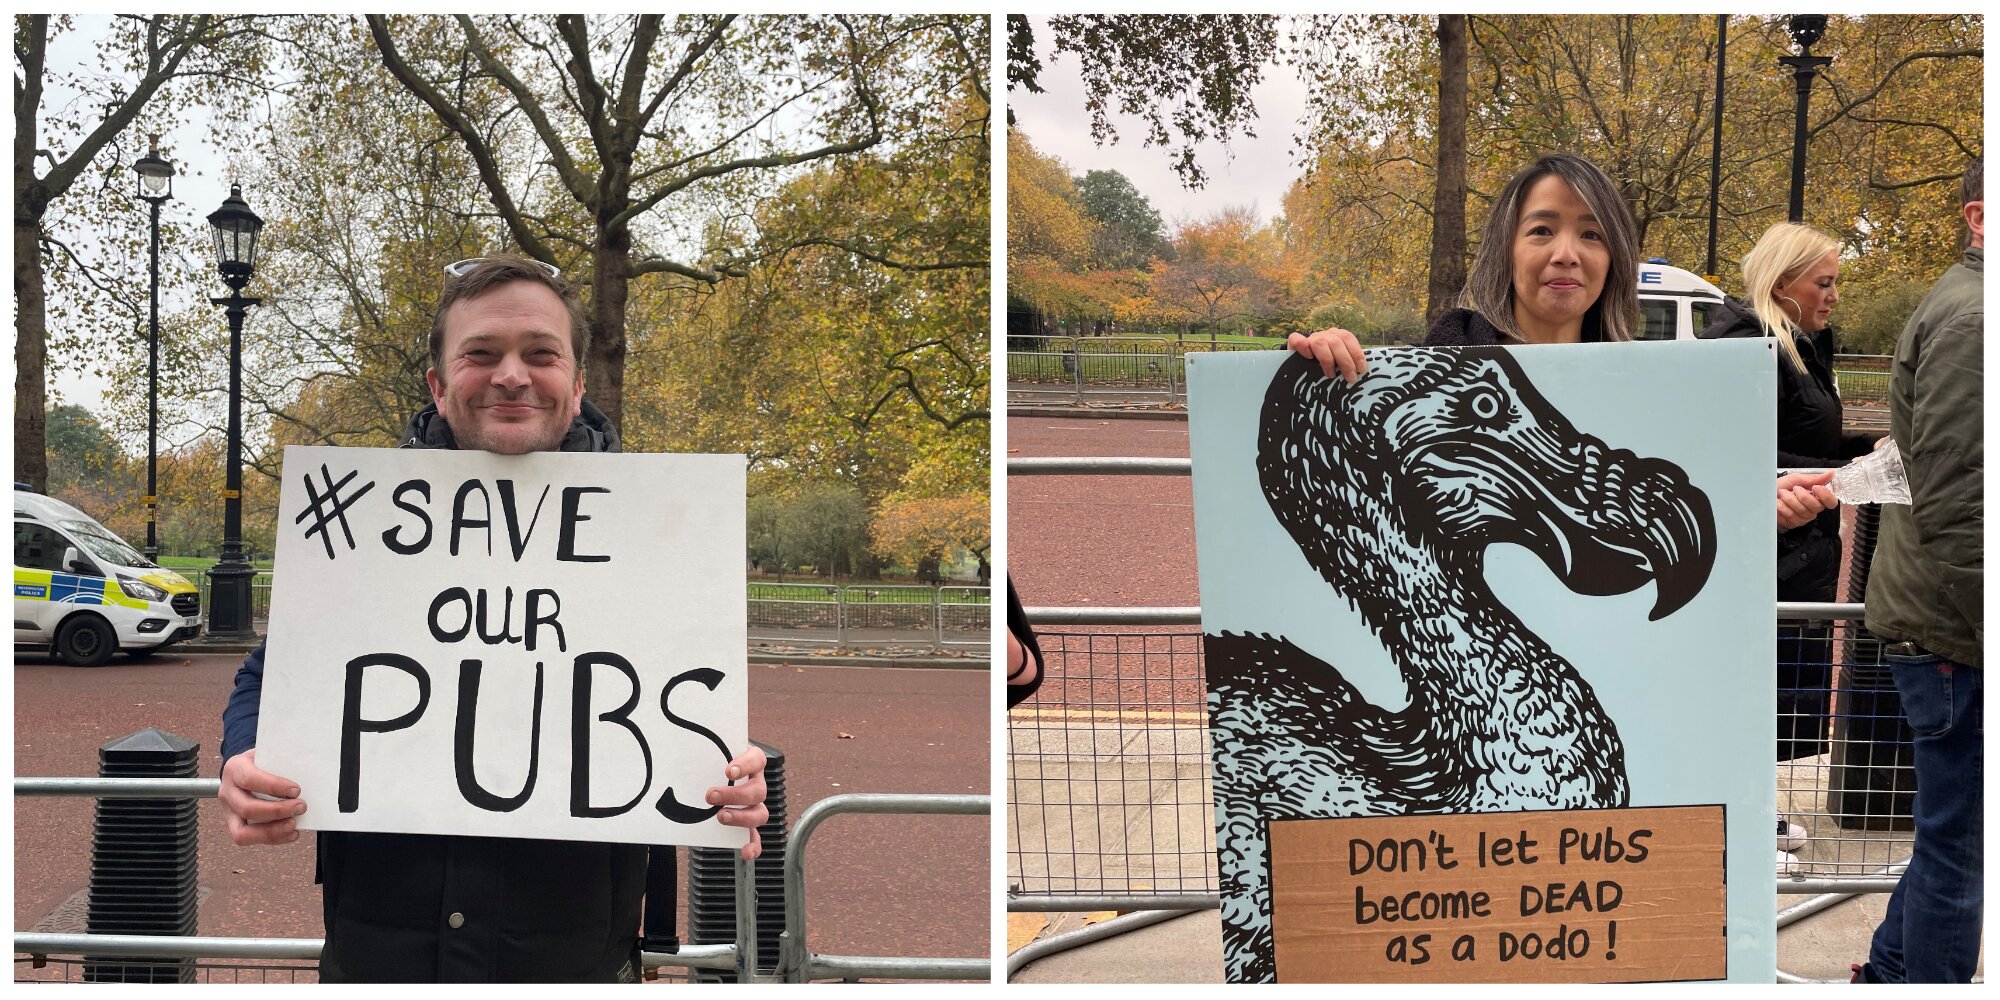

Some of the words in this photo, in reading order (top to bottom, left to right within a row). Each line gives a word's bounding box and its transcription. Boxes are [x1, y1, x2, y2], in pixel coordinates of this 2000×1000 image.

[295, 463, 612, 563] #SAVE
[337, 651, 736, 825] PUBS
[1348, 829, 1459, 876] Don't
[1478, 830, 1539, 868] let
[1355, 885, 1492, 925] become
[1520, 880, 1623, 917] DEAD
[1385, 933, 1432, 965] as
[1451, 934, 1476, 961] a
